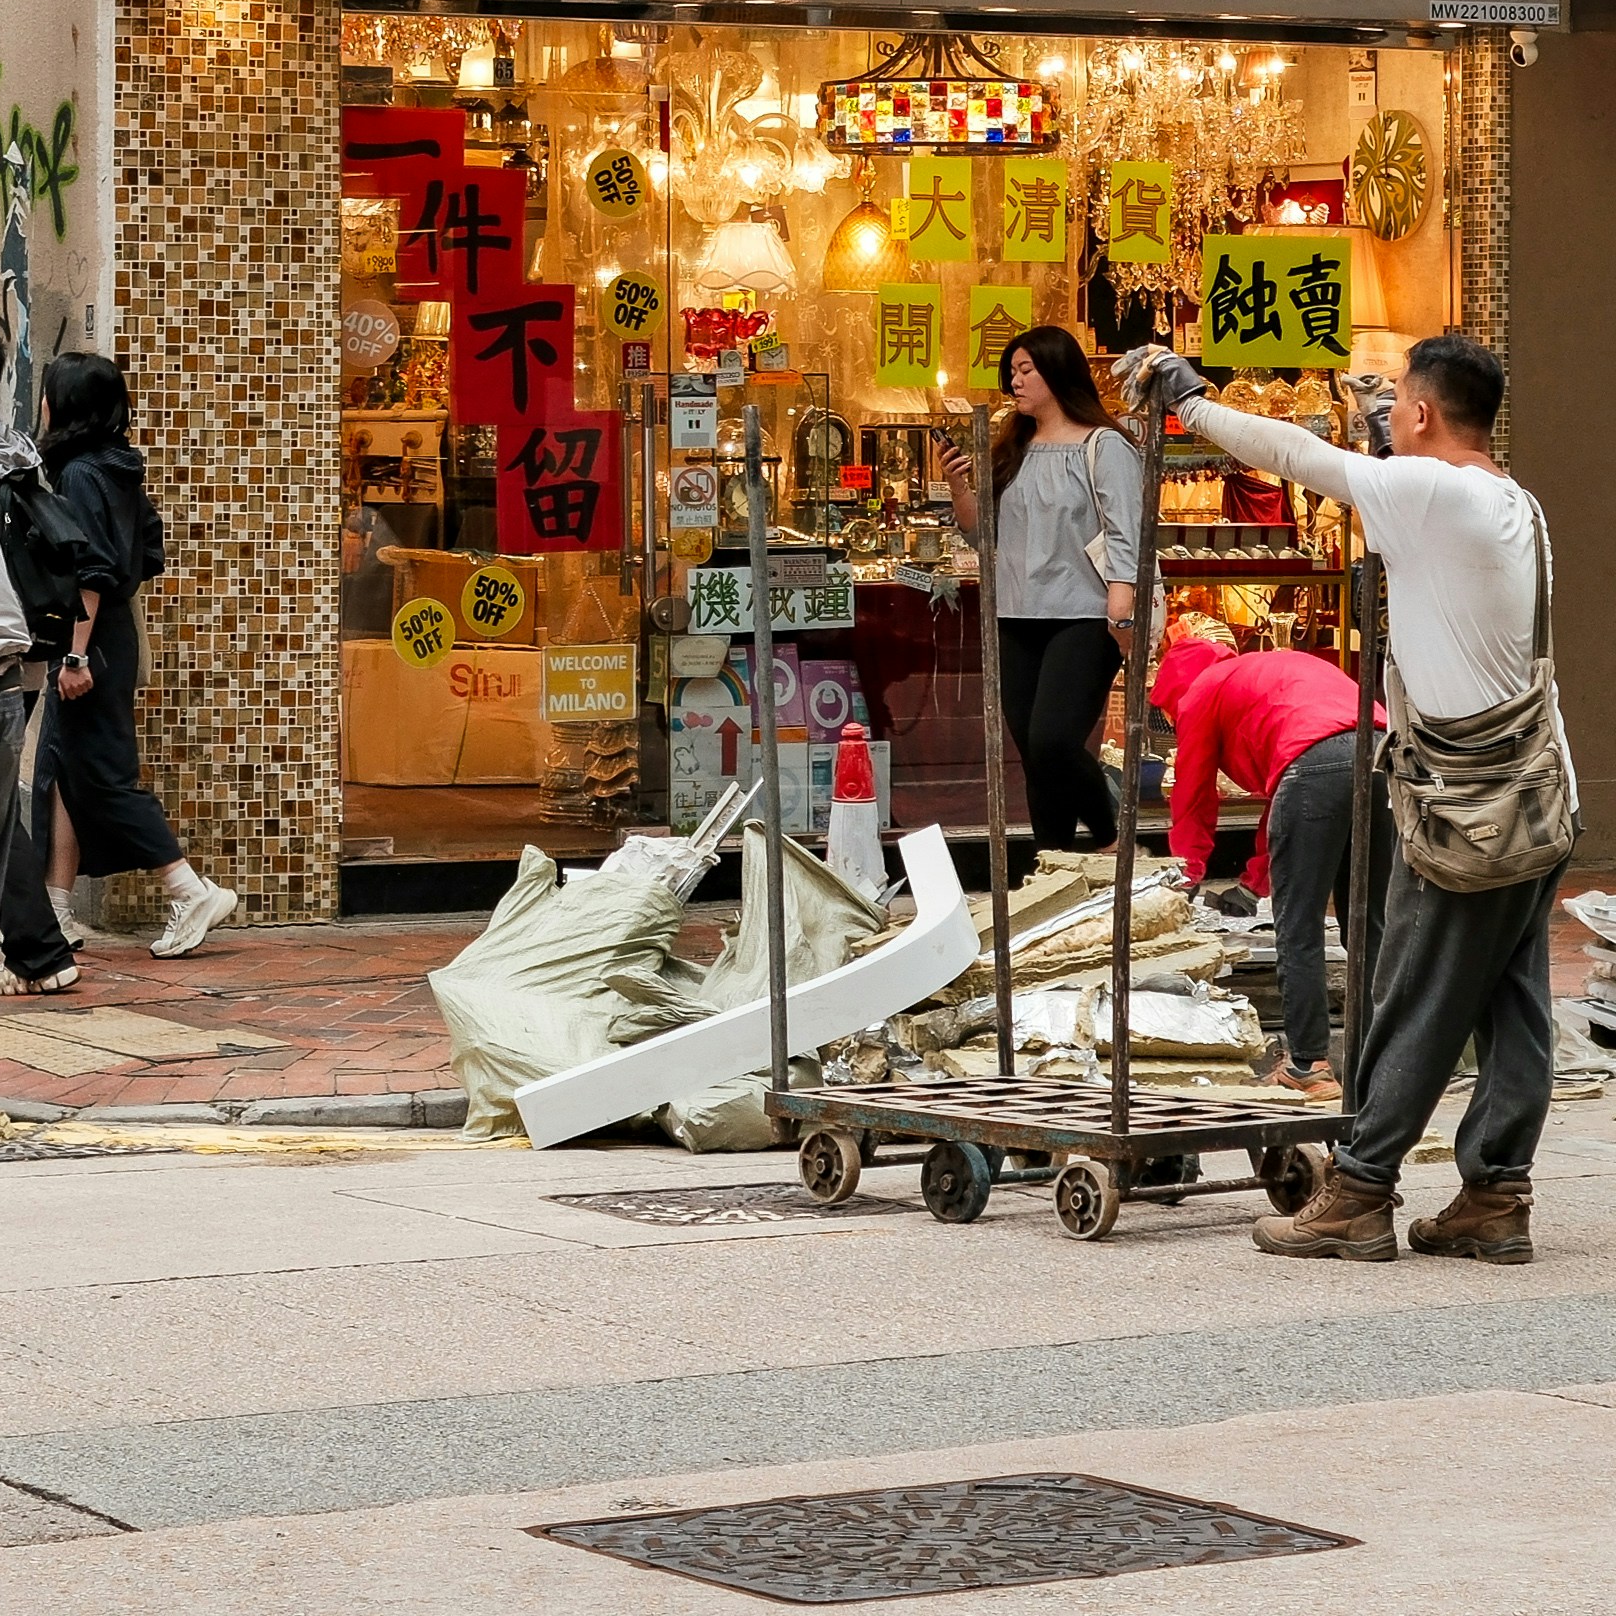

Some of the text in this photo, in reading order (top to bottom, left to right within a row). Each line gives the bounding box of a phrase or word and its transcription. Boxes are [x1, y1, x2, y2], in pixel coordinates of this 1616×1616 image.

[1430, 2, 1546, 23] MW221008300
[593, 169, 622, 205] OFF
[610, 155, 642, 206] 50%
[909, 175, 1167, 246] 大清貨
[614, 277, 660, 311] 50%
[1205, 252, 1352, 357] 蝕賣
[343, 310, 396, 346] 40%
[613, 303, 649, 332] OFF
[345, 138, 601, 543] 一件不留
[346, 335, 384, 358] OFF
[879, 301, 1027, 372] 開倉
[626, 345, 647, 368] 推
[674, 400, 714, 409] Handmade
[895, 566, 932, 584] SEIKO
[473, 574, 519, 608] 50%
[398, 604, 444, 642] 50%
[472, 599, 509, 627] OFF
[412, 627, 444, 660] OFF
[549, 655, 628, 672] WELCOME
[579, 677, 597, 690] TO
[549, 692, 627, 712] MILANO
[673, 789, 725, 809] 往上層
